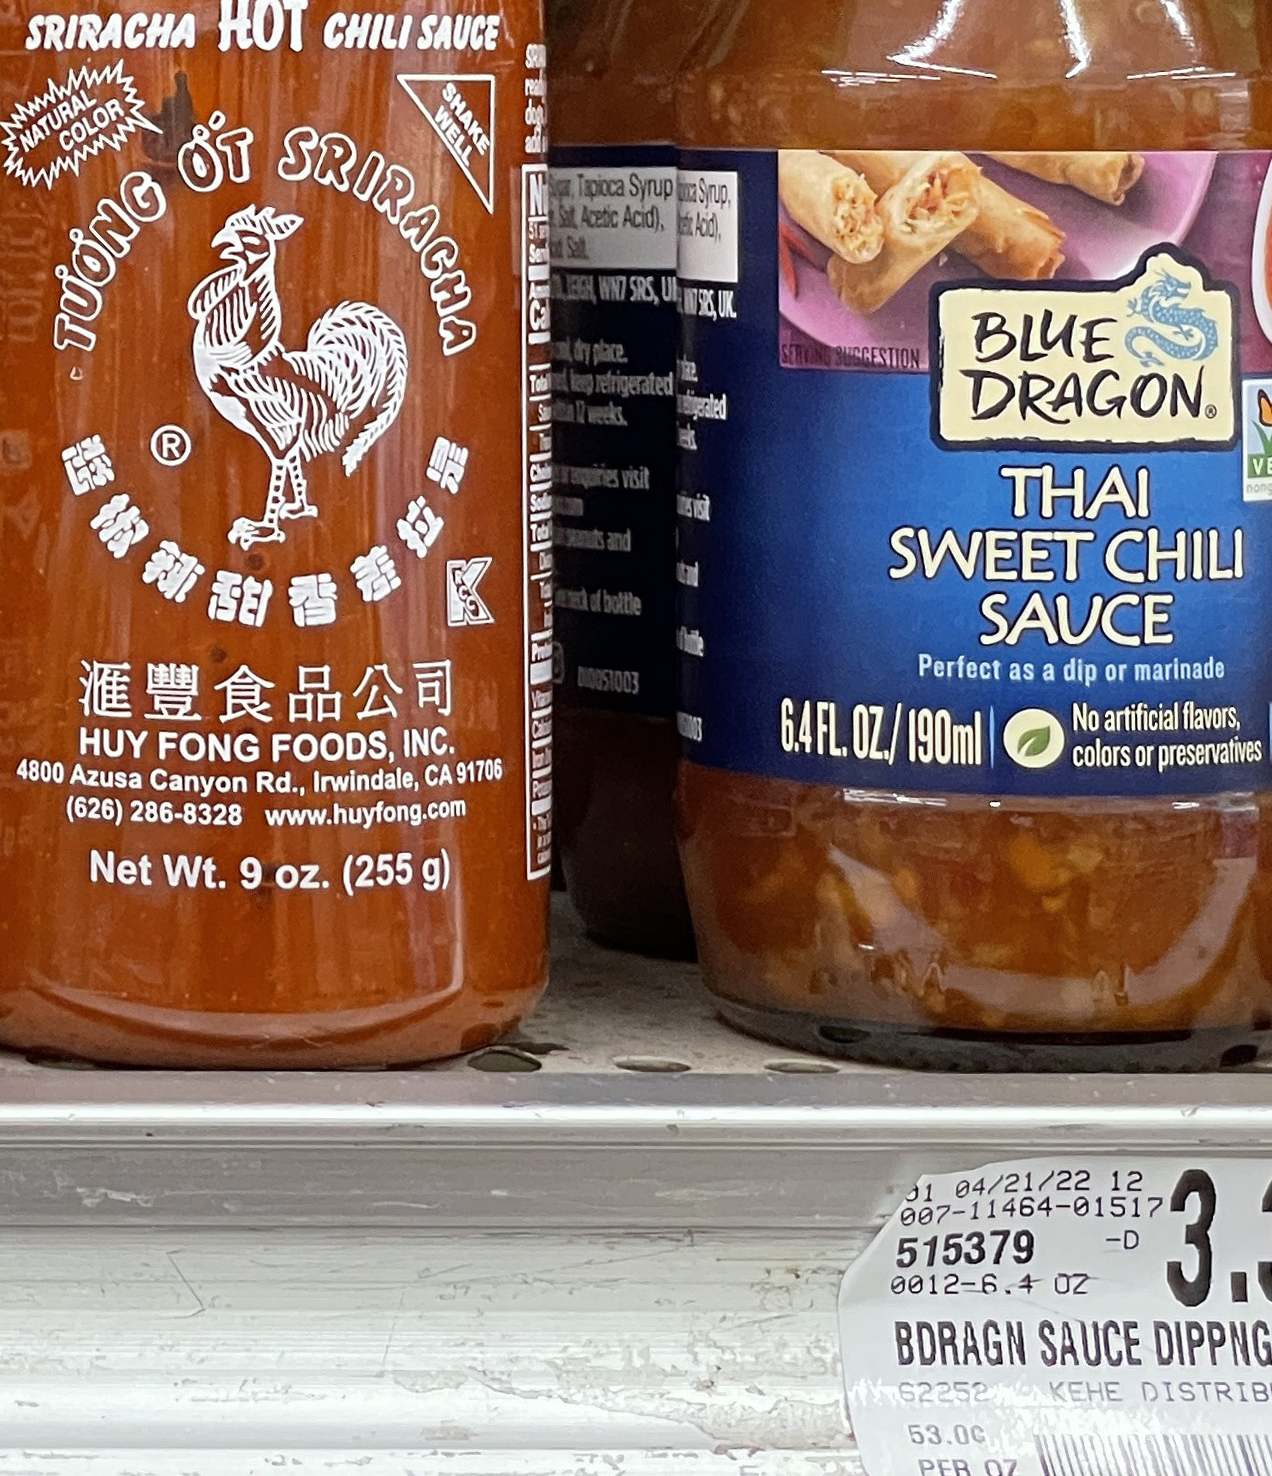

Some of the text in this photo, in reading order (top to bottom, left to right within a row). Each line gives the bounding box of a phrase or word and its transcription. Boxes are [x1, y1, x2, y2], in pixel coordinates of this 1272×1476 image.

[26, 13, 195, 50] SRIRACHA
[322, 11, 410, 48] CHILI
[415, 15, 500, 50] SAUCE
[972, 309, 1117, 364] BLUE
[960, 365, 1204, 425] DRAGON
[1000, 465, 1149, 518] THAI
[891, 529, 1244, 581] SWEET CHILI
[980, 594, 1173, 646] SAUCE
[918, 653, 1225, 687] Perfect as a dip or marinade
[780, 698, 812, 753] 6.4
[817, 702, 848, 757] FL.
[908, 708, 981, 766] 190ml
[1073, 701, 1240, 733] No artificial flavors,
[79, 726, 455, 765] HUY FONG FOODS, INC.
[1073, 736, 1261, 772] colors or preservatives
[266, 798, 466, 828] www.huyfong.com
[956, 1170, 1090, 1198] 04/21/22
[1111, 1171, 1143, 1192] 12
[901, 1196, 1163, 1226] 007-11464-01517
[896, 1229, 1139, 1267] 515379 -D
[1166, 1169, 1272, 1307] 3.
[890, 1273, 1089, 1295] 0012-6.4 OZ
[895, 1320, 1272, 1367] BDRAGN SAUCE DIPPNG
[1050, 1382, 1122, 1403] KEHE
[1142, 1382, 1272, 1403] DISTRIB
